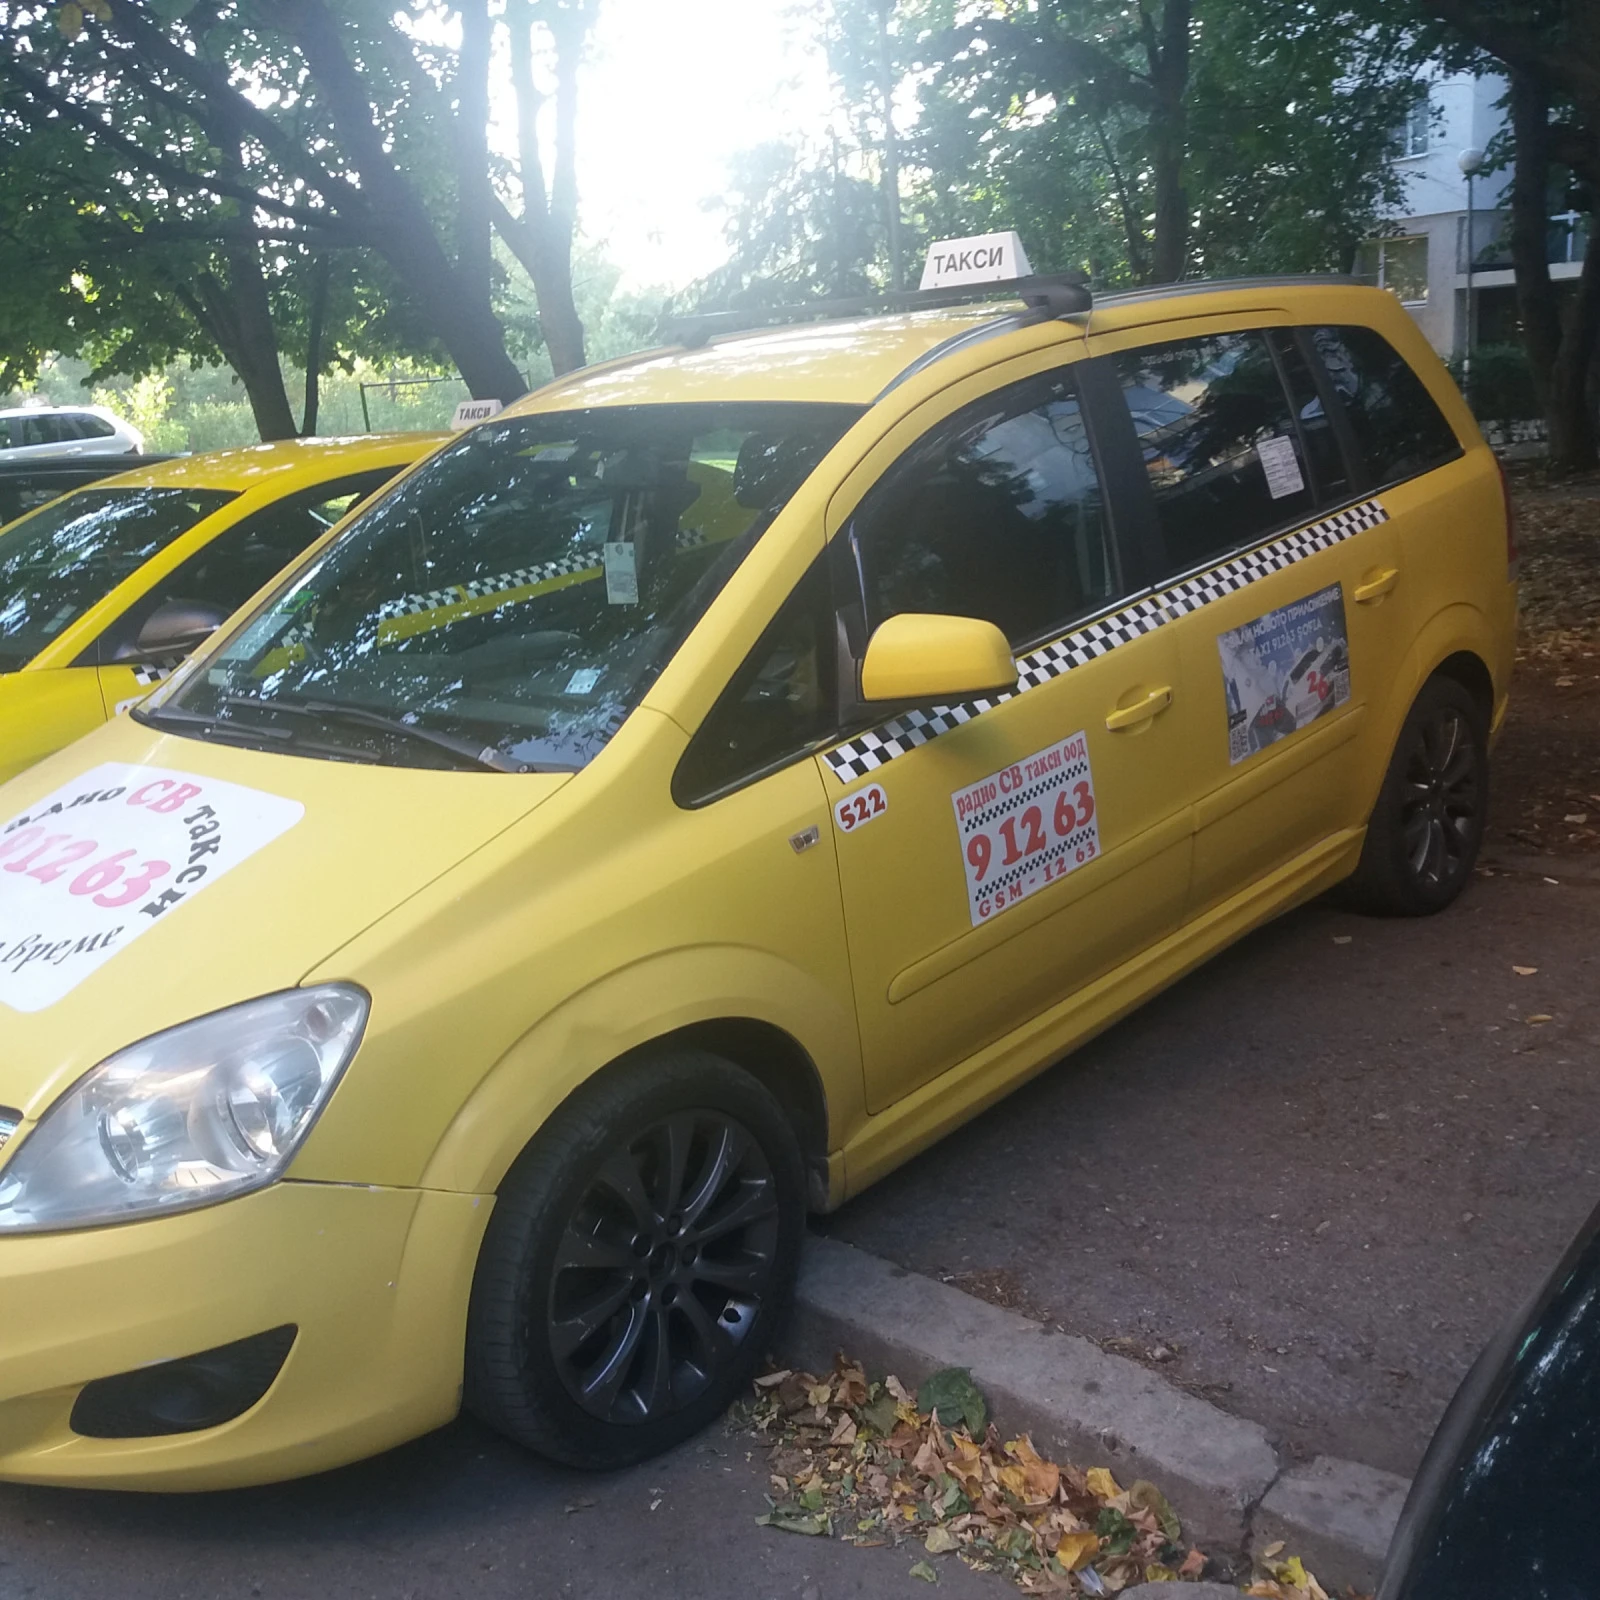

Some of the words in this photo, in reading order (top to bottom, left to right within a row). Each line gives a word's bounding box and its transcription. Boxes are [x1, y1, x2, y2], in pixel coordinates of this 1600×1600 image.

[933, 246, 1004, 275] ТАКСИ
[460, 407, 491, 421] ТАКСИ
[956, 783, 996, 821] радио
[1024, 749, 1062, 781] такси
[839, 788, 886, 830] 522
[139, 804, 221, 918] такси
[978, 882, 1023, 918] GSM
[0, 925, 124, 973] време
